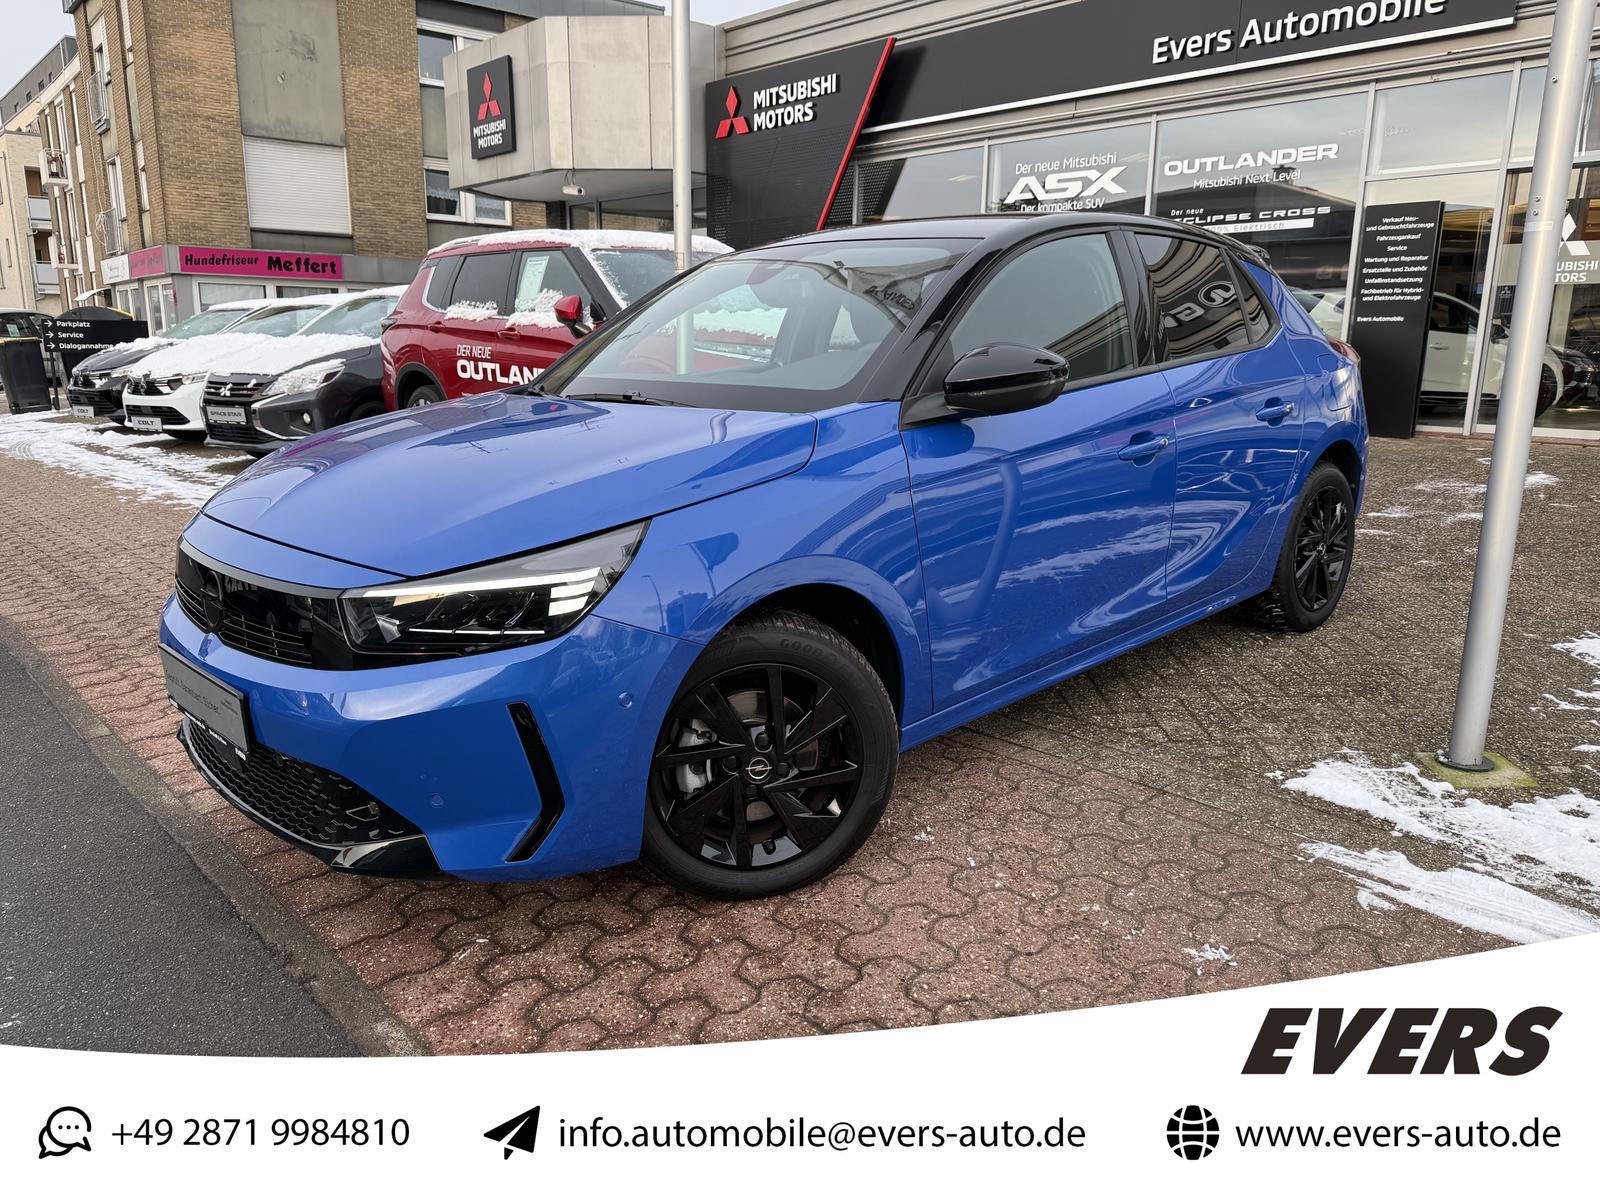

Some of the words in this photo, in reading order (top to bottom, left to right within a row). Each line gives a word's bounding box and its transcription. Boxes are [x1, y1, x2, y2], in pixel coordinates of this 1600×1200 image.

[1152, 29, 1232, 64] Evers
[1240, 0, 1445, 48] Automobile
[753, 73, 837, 110] MITSUBISHI
[753, 102, 814, 131] MOTORS
[473, 118, 507, 138] MITSUBISHI
[478, 132, 503, 149] MOTORS
[1015, 163, 1032, 174] Der
[1035, 161, 1060, 173] neue
[1063, 152, 1118, 169] Mitsubishi
[1163, 143, 1339, 176] OUTLANDER
[1003, 165, 1128, 204] ASX
[1193, 174, 1243, 190] Mitsubishi
[1020, 204, 1036, 212] Der
[1038, 199, 1083, 212] kompakte
[1085, 198, 1105, 209] SUV
[1259, 206, 1331, 219] CROSS
[1376, 233, 1421, 241] Fahrzeugankauf
[184, 254, 259, 267] Hundefriseur
[267, 255, 337, 275] Meffert
[1556, 260, 1599, 271] UBISHI
[1555, 272, 1587, 283] TORS
[56, 320, 91, 328] Parkplatz
[456, 344, 471, 357] DER
[471, 345, 492, 359] NEUE
[456, 358, 546, 386] OUTLAN
